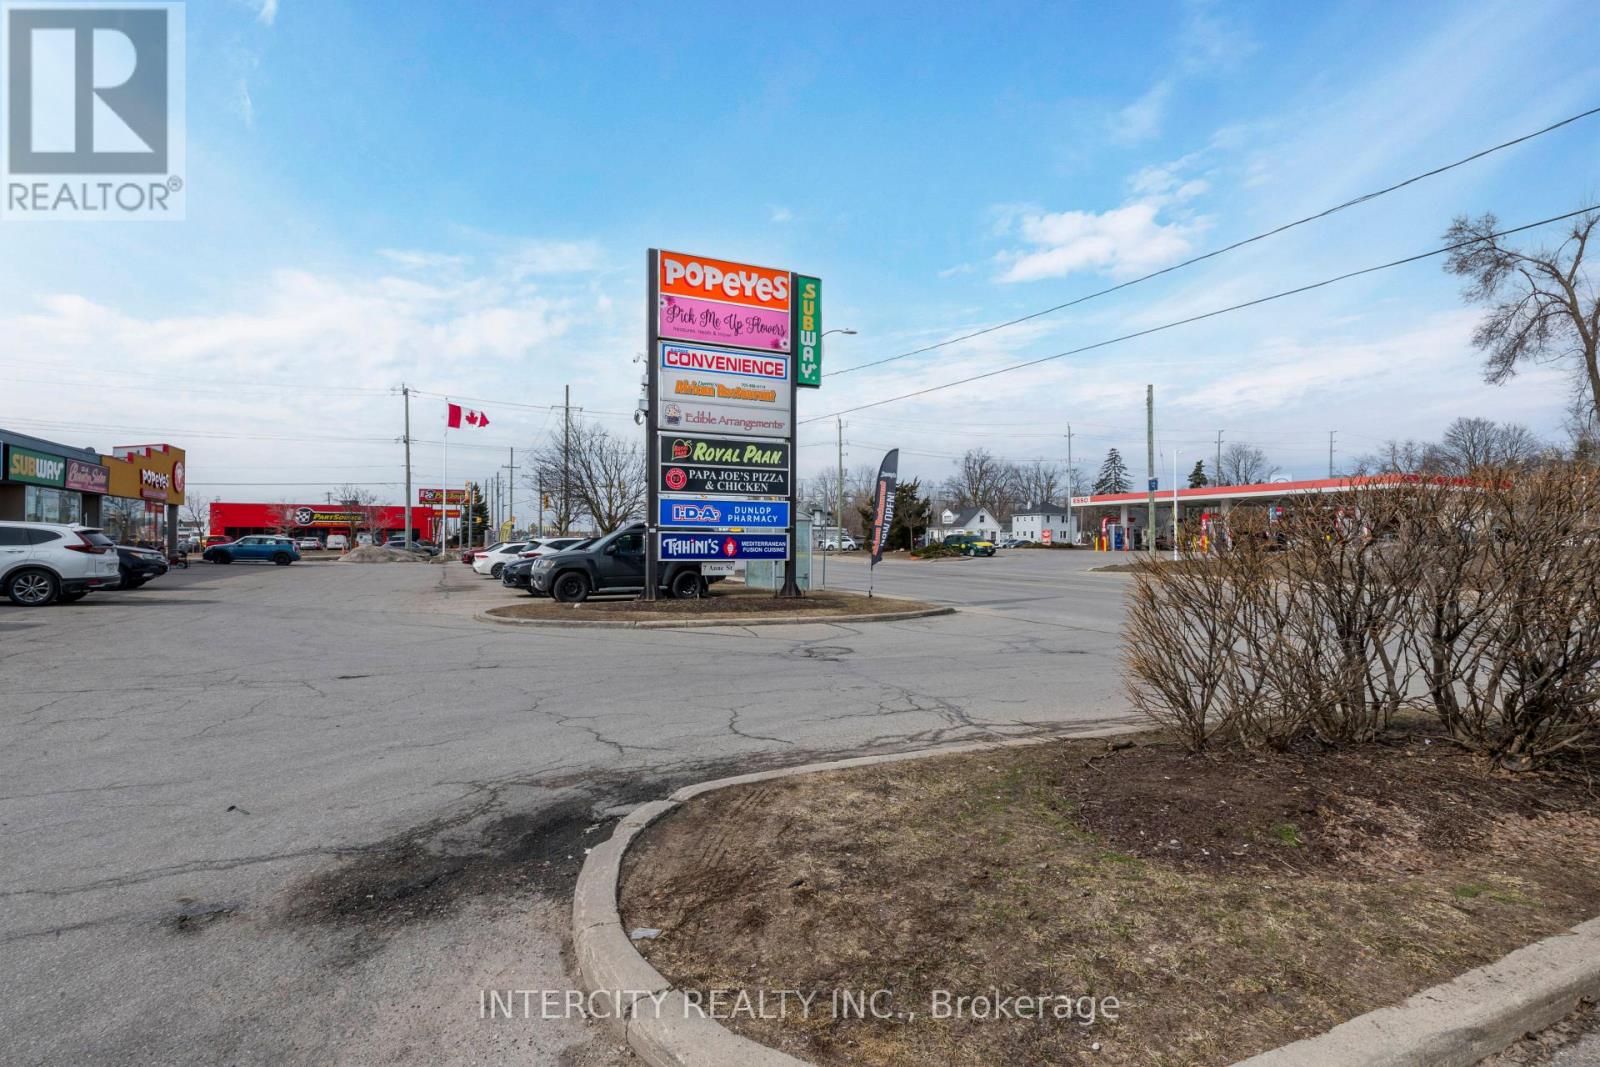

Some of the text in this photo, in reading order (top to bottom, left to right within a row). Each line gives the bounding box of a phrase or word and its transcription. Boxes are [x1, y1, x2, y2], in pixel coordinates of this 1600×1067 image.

[666, 304, 697, 324] Pick
[700, 309, 721, 330] Me
[724, 313, 744, 336] Up
[745, 316, 787, 337] Flowers
[800, 283, 817, 380] SUBWAY
[666, 350, 784, 376] CONVENIENCE
[685, 411, 784, 430] Edible Arrangements
[693, 442, 740, 463] ROYAL
[743, 445, 781, 464] PAAN
[10, 454, 64, 481] SUBWAY
[689, 469, 716, 480] PAPA
[718, 471, 750, 481] JOE'S
[752, 473, 784, 483] PIZZA
[705, 481, 768, 492] & CHICKEN
[727, 515, 778, 523] PHARMACY
[735, 506, 771, 514] DUNLOP
